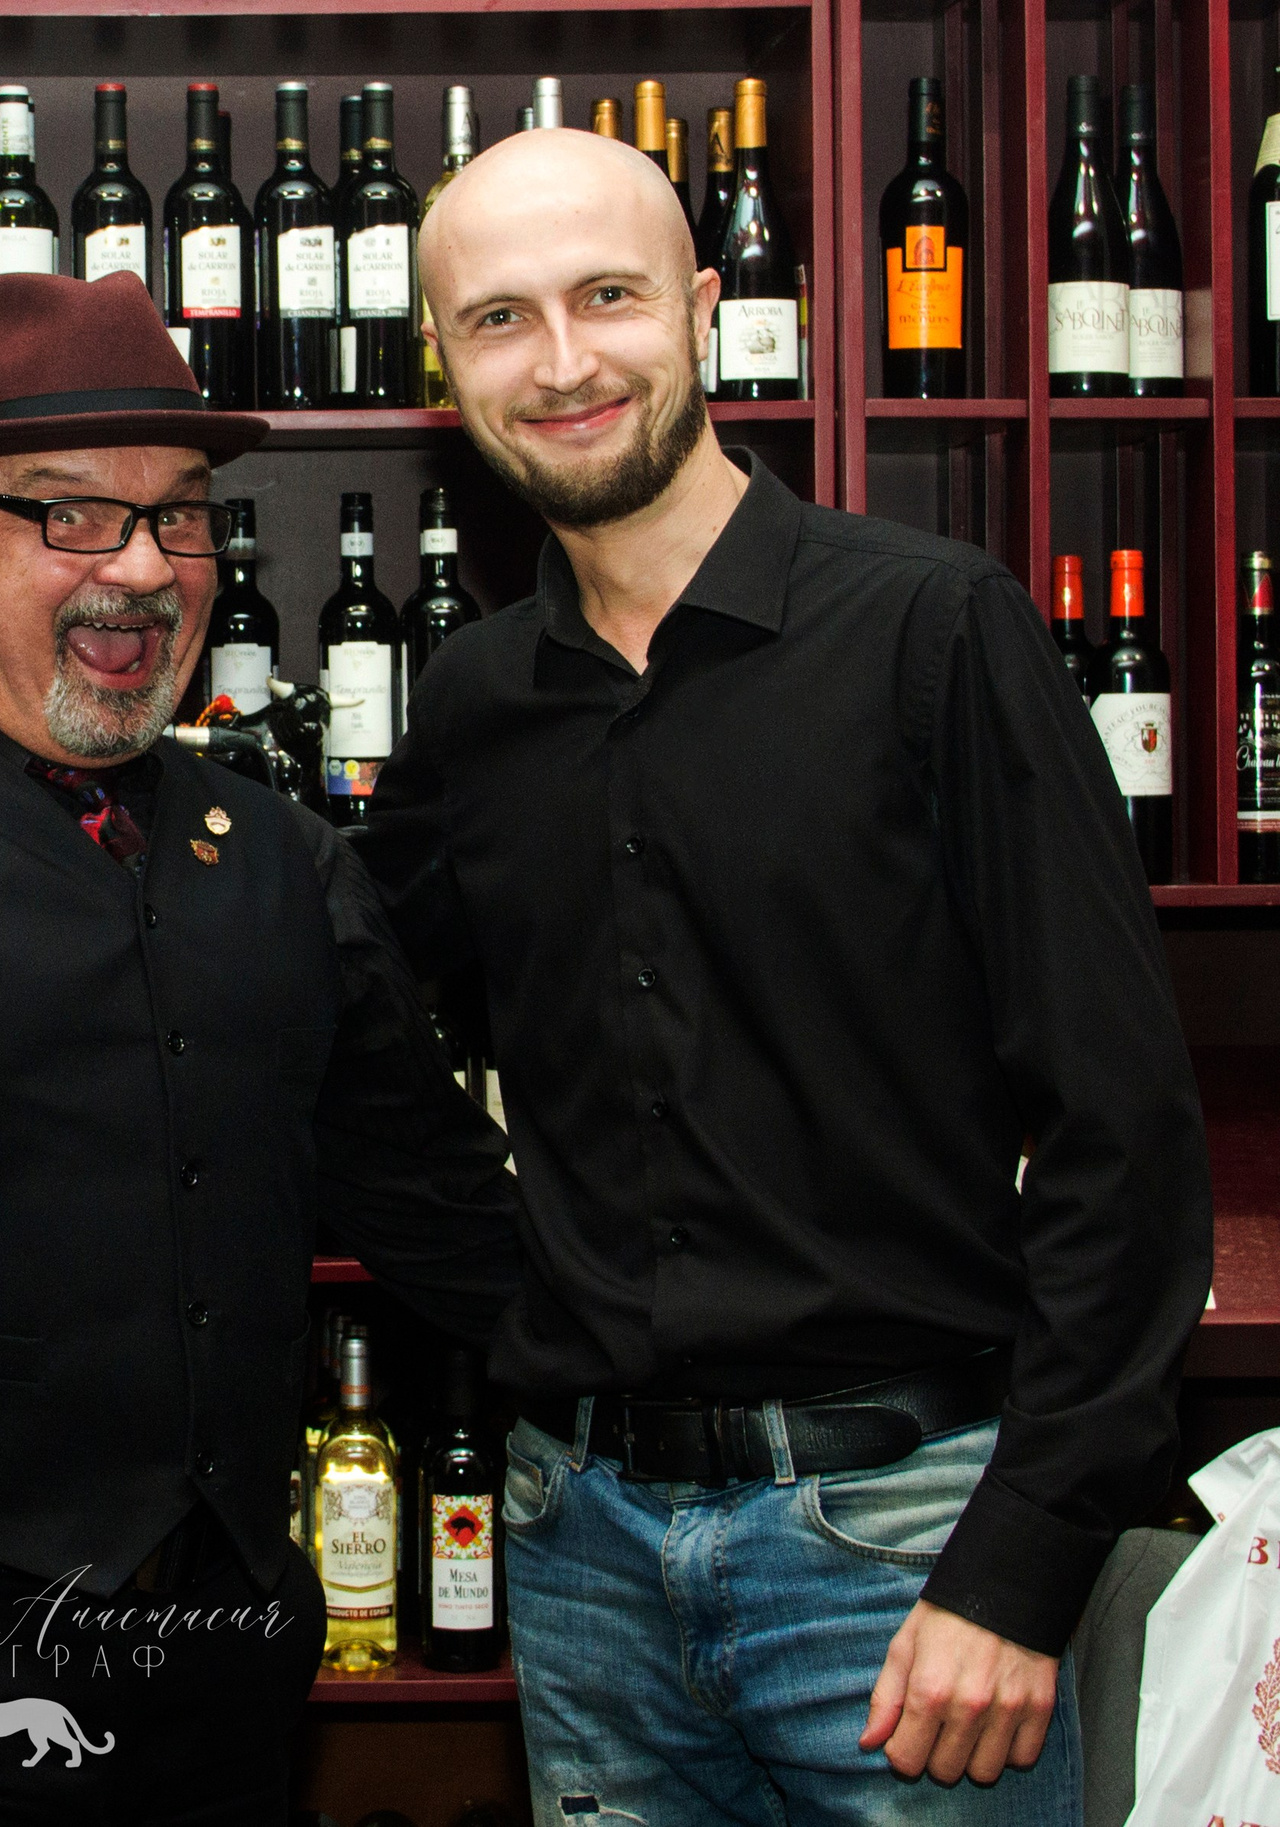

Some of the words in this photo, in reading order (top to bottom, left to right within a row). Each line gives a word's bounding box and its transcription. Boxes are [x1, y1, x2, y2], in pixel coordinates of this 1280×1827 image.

[101, 251, 131, 260] SOLAR
[198, 251, 228, 260] SOLAR
[296, 252, 325, 261] SOLAR
[362, 252, 393, 261] SOLAR
[738, 304, 783, 318] ARROBA
[352, 1531, 367, 1544] EL
[331, 1538, 387, 1555] SIERRO
[449, 1568, 478, 1582] MESA
[438, 1586, 451, 1599] DE
[453, 1584, 490, 1599] MUNDO
